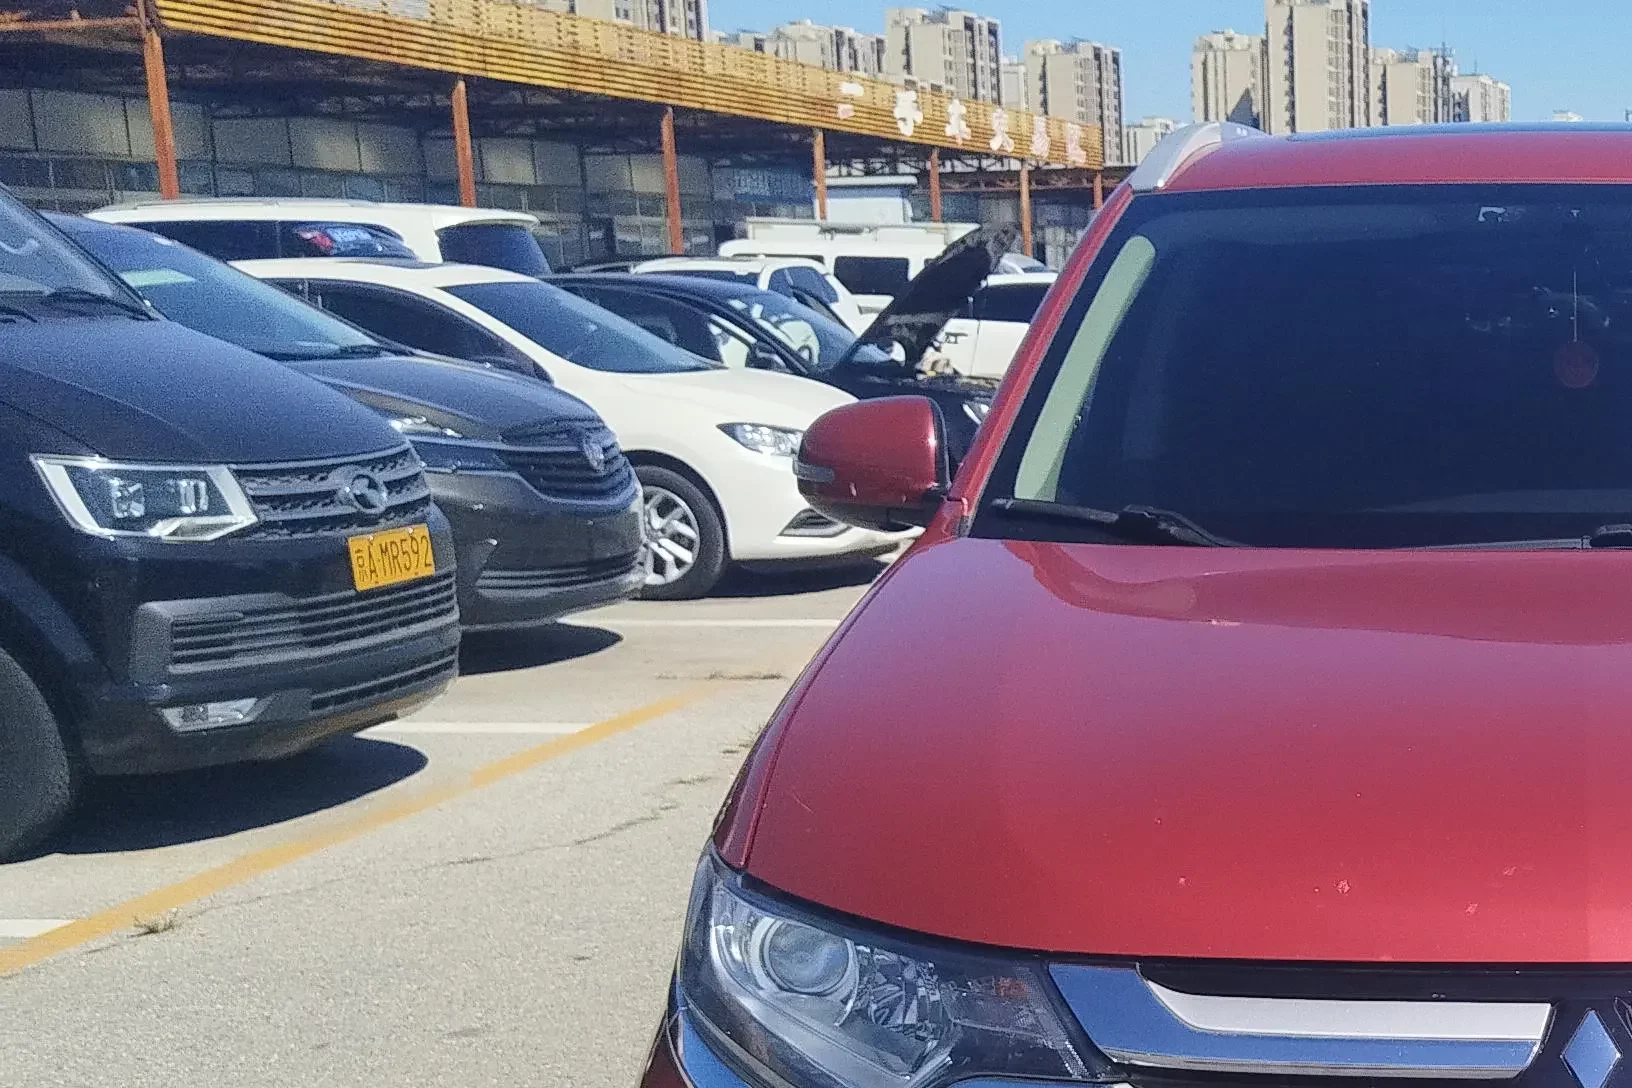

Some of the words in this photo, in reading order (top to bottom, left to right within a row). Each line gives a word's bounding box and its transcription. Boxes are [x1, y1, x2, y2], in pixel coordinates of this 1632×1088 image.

[837, 81, 1087, 164] 二手车交易区
